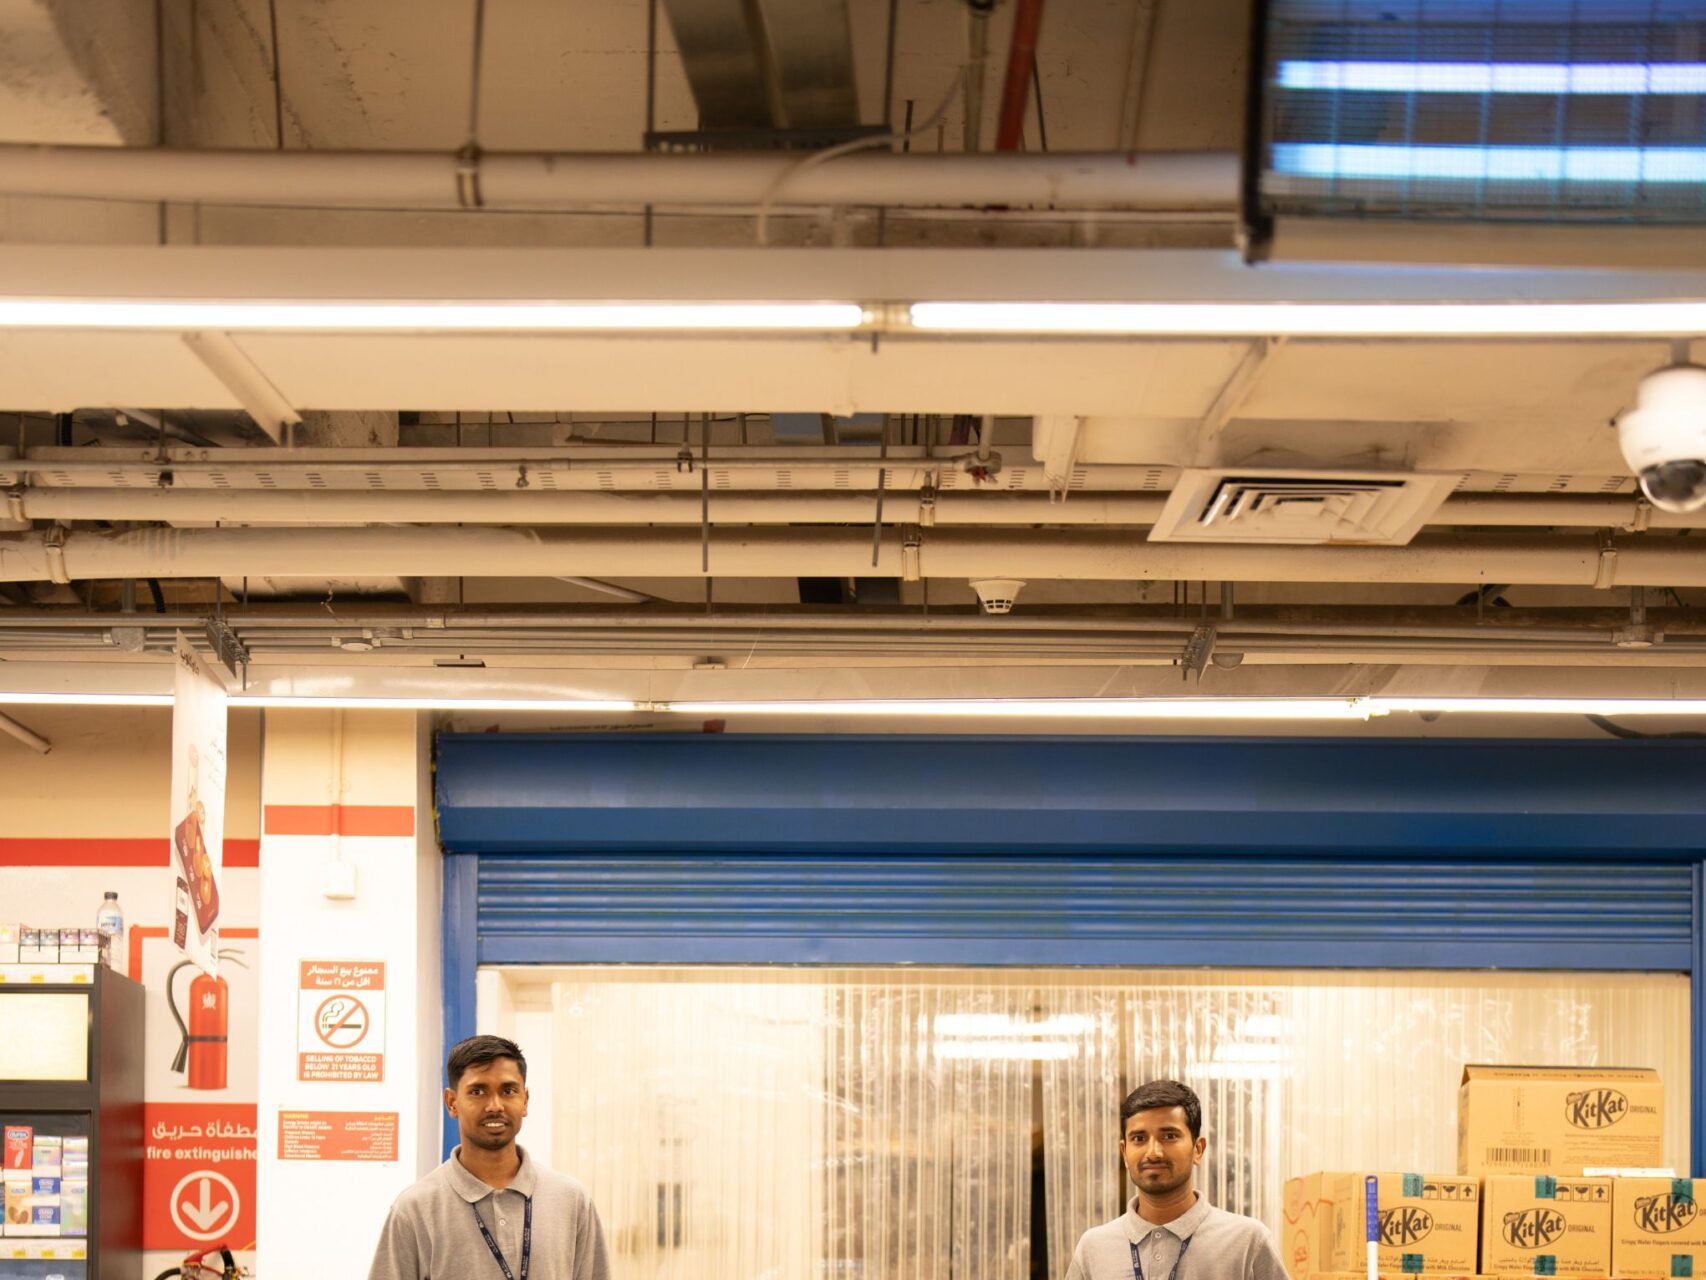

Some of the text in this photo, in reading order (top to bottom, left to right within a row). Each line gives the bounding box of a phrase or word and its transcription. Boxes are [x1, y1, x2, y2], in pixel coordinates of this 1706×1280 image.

[304, 1063, 329, 1071] BELOW
[340, 1063, 361, 1071] YEARS
[362, 1063, 377, 1071] OLD
[305, 1055, 377, 1063] SELLING OF TOBACCO
[312, 1071, 353, 1079] PROHIBITED
[363, 1071, 379, 1079] LAW
[1573, 1089, 1657, 1128] KitKat ORIGINAL
[151, 1121, 203, 1141] حريق
[146, 1145, 257, 1163] fire extinguishe
[1642, 1195, 1694, 1232] KitKat
[1378, 1208, 1463, 1245] KitKat ORIGINAL
[1510, 1209, 1562, 1247] KitKat
[1567, 1224, 1595, 1233] ORIGINAL
